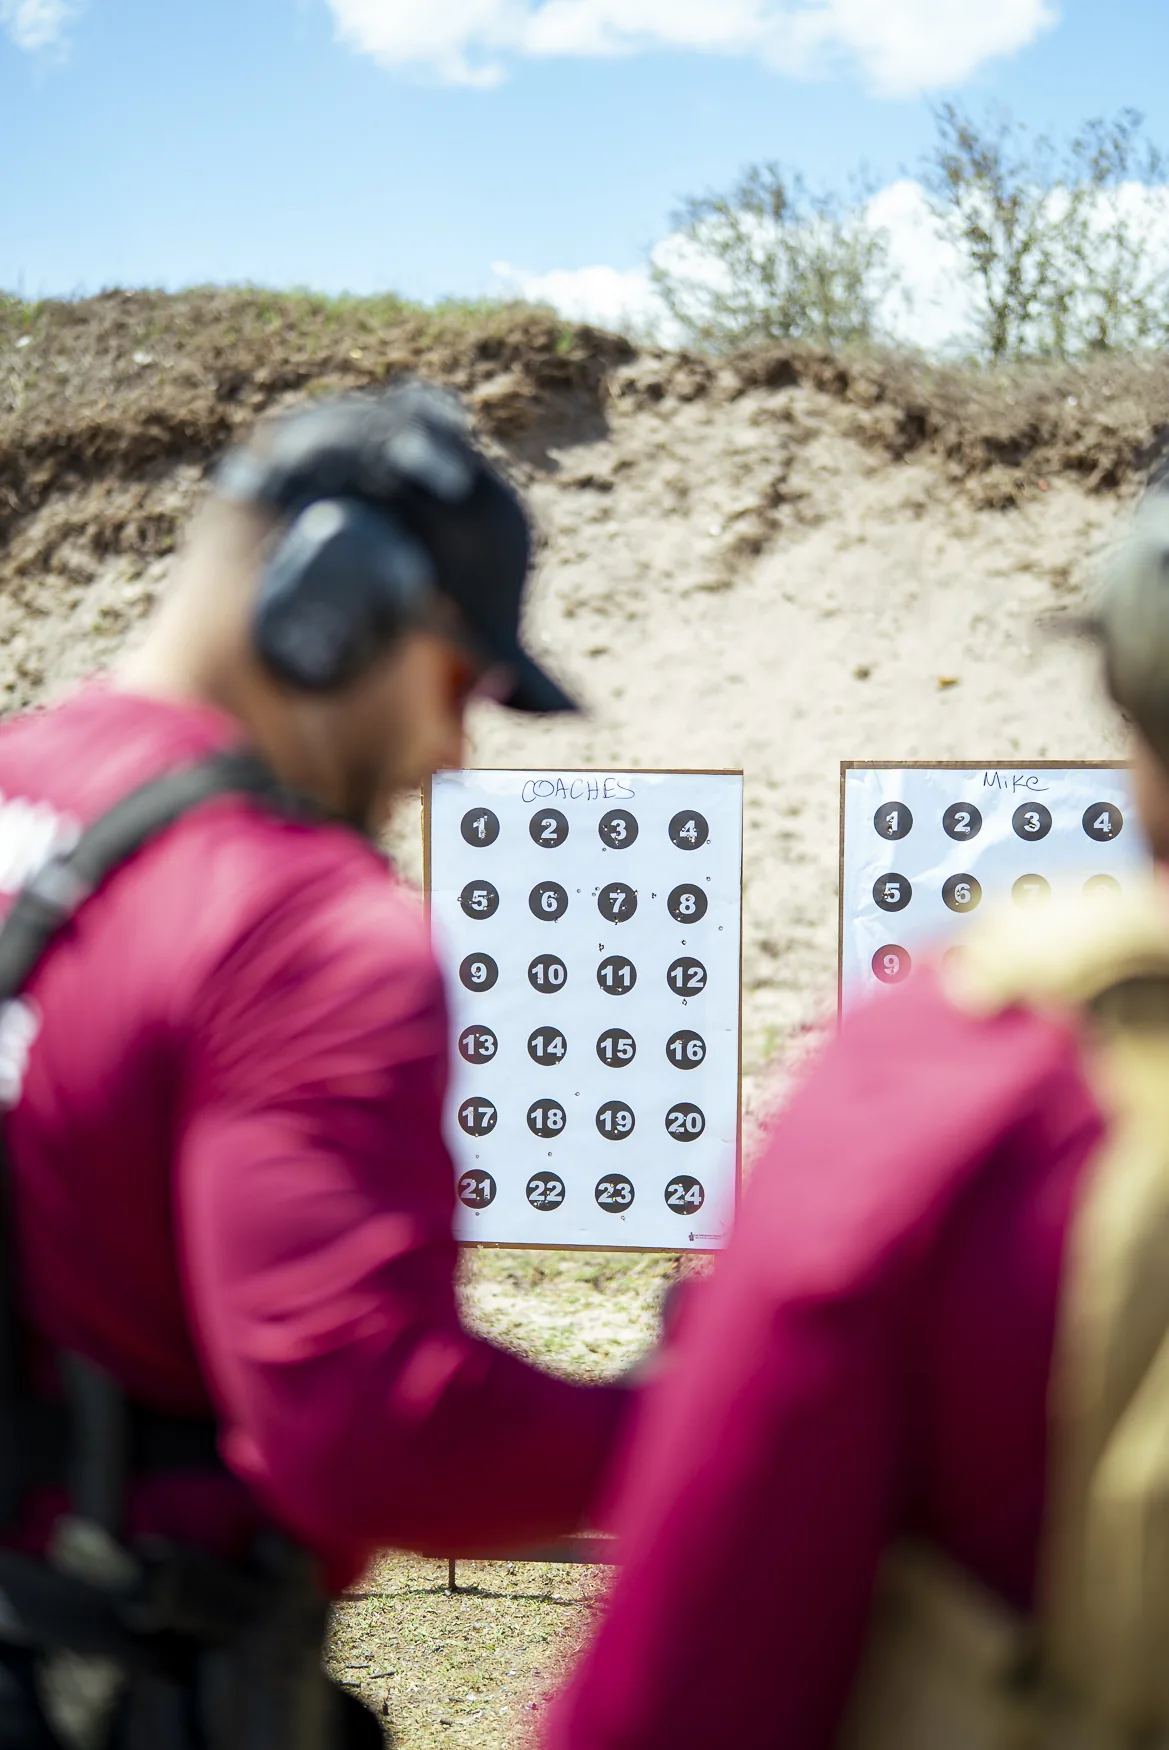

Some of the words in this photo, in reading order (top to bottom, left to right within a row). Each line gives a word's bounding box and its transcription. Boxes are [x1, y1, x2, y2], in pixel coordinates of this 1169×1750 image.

[522, 778, 635, 802] COACHES
[473, 817, 486, 838] 1
[541, 819, 557, 839] 2
[610, 819, 627, 839] 3
[679, 820, 698, 838] 4
[886, 811, 898, 831] 1
[954, 811, 970, 832] 2
[1024, 811, 1040, 832] 3
[1094, 812, 1112, 832] 4
[471, 890, 488, 911] 5
[541, 891, 557, 912] 6
[609, 893, 626, 913] 7
[679, 894, 696, 914] 8
[883, 883, 900, 903] 5
[954, 883, 971, 903] 6
[471, 963, 487, 983] 9
[532, 964, 564, 984] 10
[601, 965, 631, 986] 11
[671, 967, 704, 987] 12
[883, 954, 900, 975] 9
[462, 1035, 495, 1055] 13
[531, 1036, 564, 1056] 14
[600, 1038, 633, 1059] 15
[670, 1040, 703, 1060] 16
[462, 1107, 495, 1127] 17
[531, 1109, 563, 1129] 18
[600, 1111, 632, 1131] 19
[668, 1112, 702, 1133] 20
[460, 1179, 490, 1199] 21
[529, 1181, 562, 1201] 22
[598, 1183, 631, 1203] 23
[668, 1184, 701, 1205] 24
